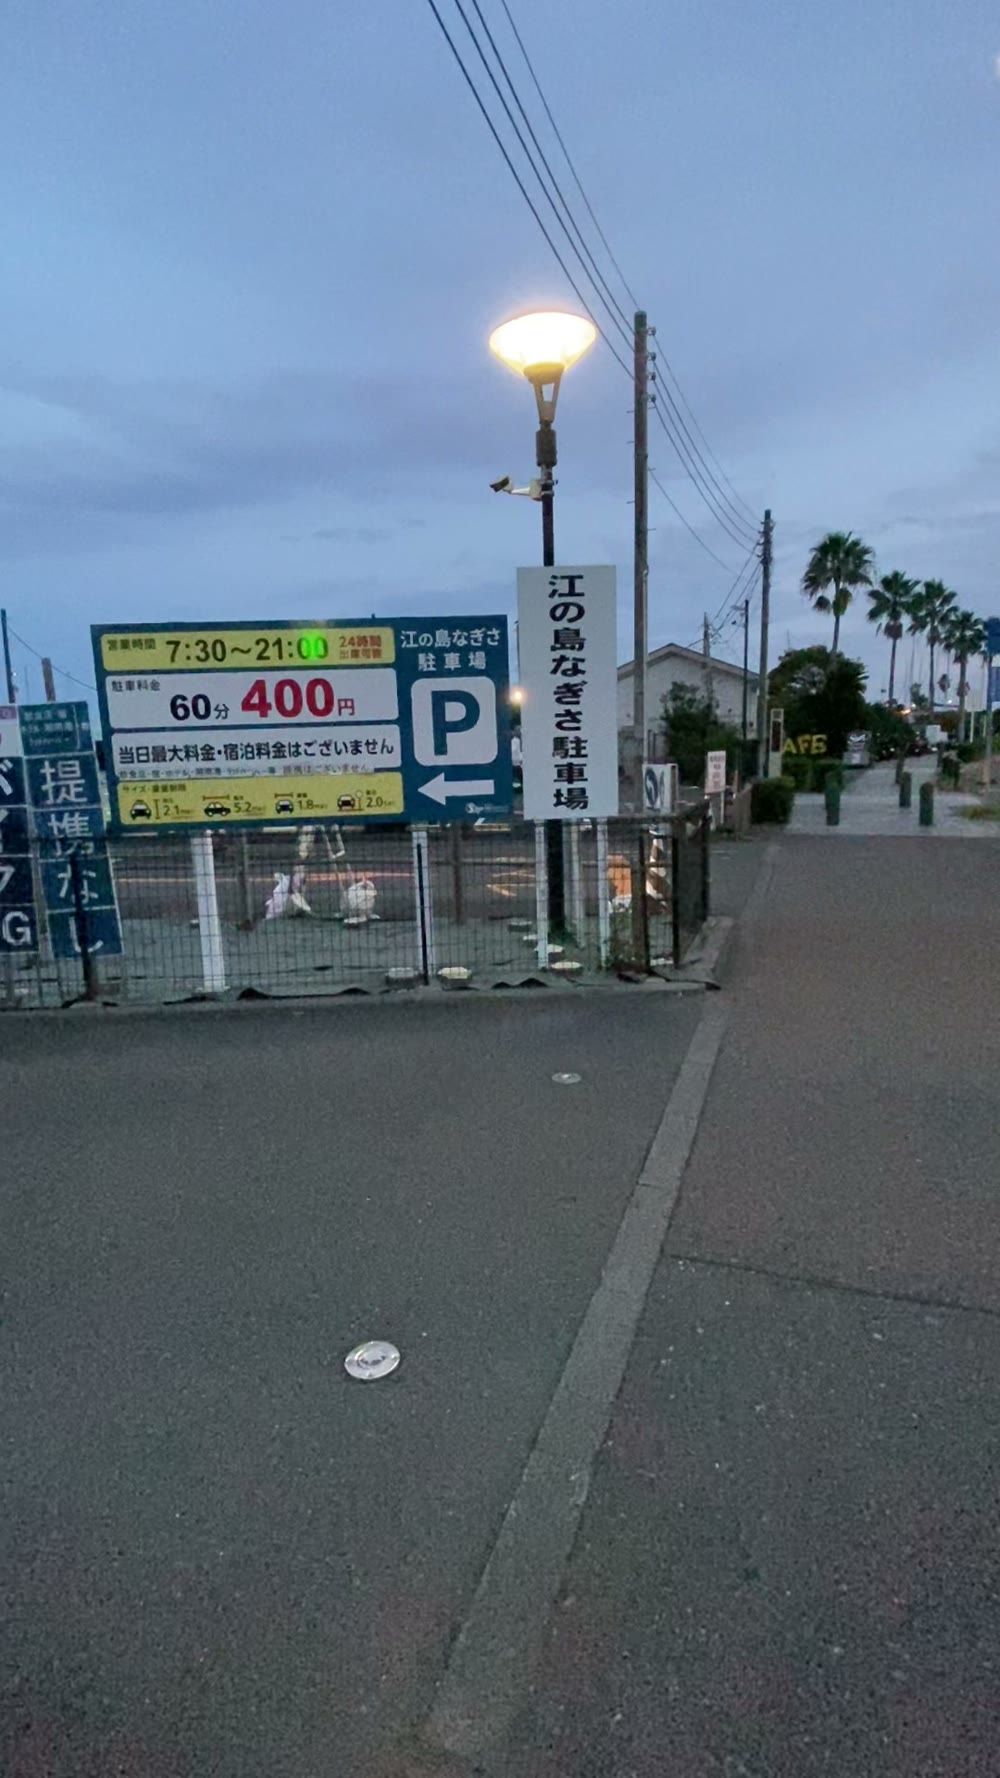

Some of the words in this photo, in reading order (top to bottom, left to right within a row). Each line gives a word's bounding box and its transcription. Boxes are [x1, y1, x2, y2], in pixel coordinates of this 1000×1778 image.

[400, 627, 501, 648] 江の島なぎさ
[418, 651, 486, 672] 駐車場
[111, 679, 161, 692] 駐車料金
[548, 574, 588, 810] 江の島なぎさ駐車場
[431, 689, 480, 756] P
